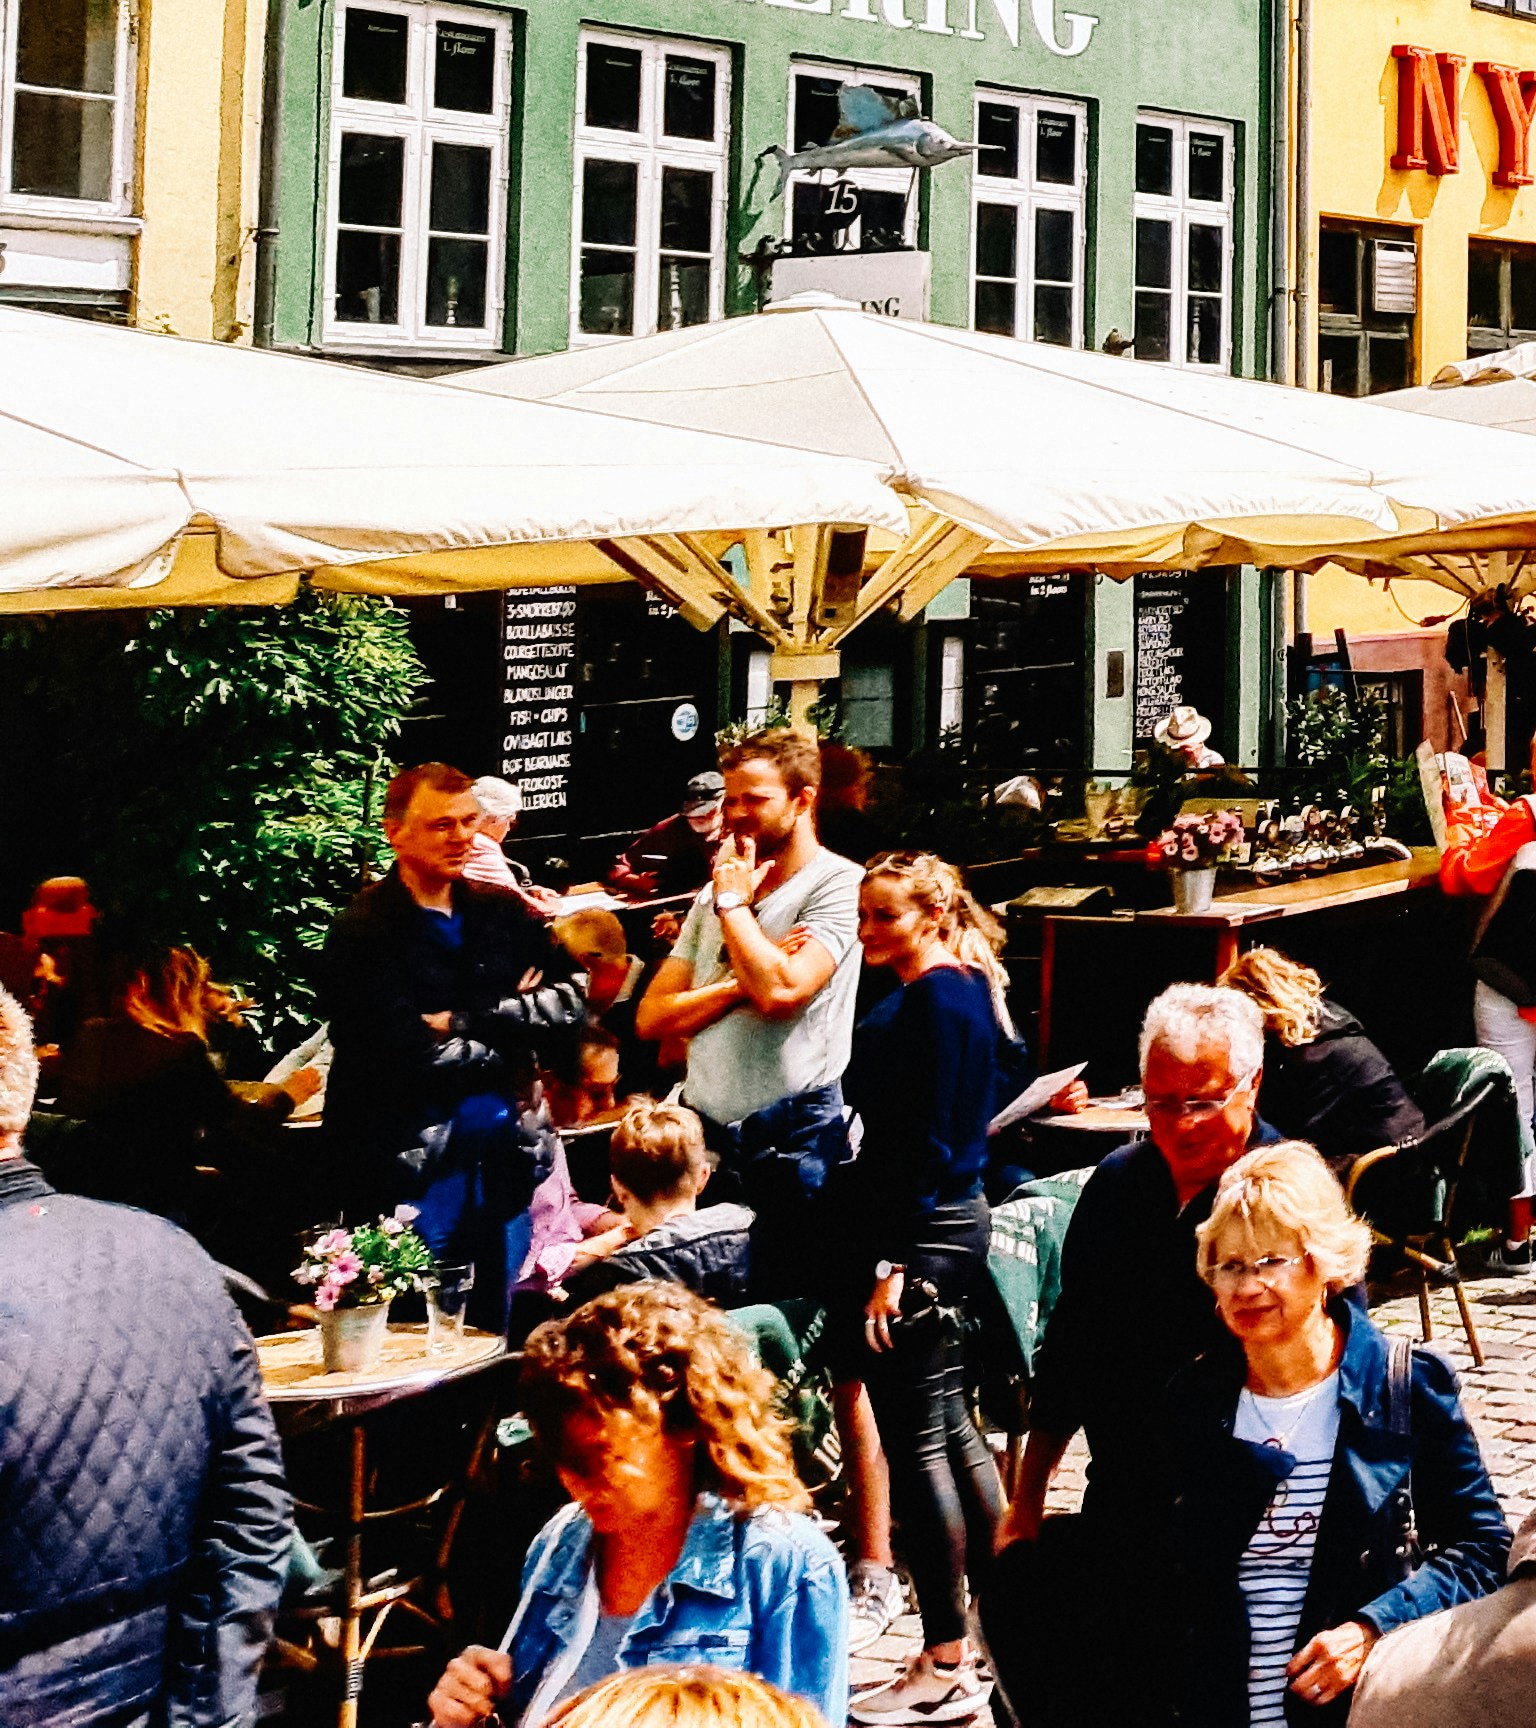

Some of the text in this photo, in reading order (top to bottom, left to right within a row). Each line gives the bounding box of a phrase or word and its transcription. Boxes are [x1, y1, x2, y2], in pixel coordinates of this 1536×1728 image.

[824, 183, 859, 215] 15
[510, 707, 568, 726] FISH CHIPS
[522, 791, 567, 811] LLERKEN
